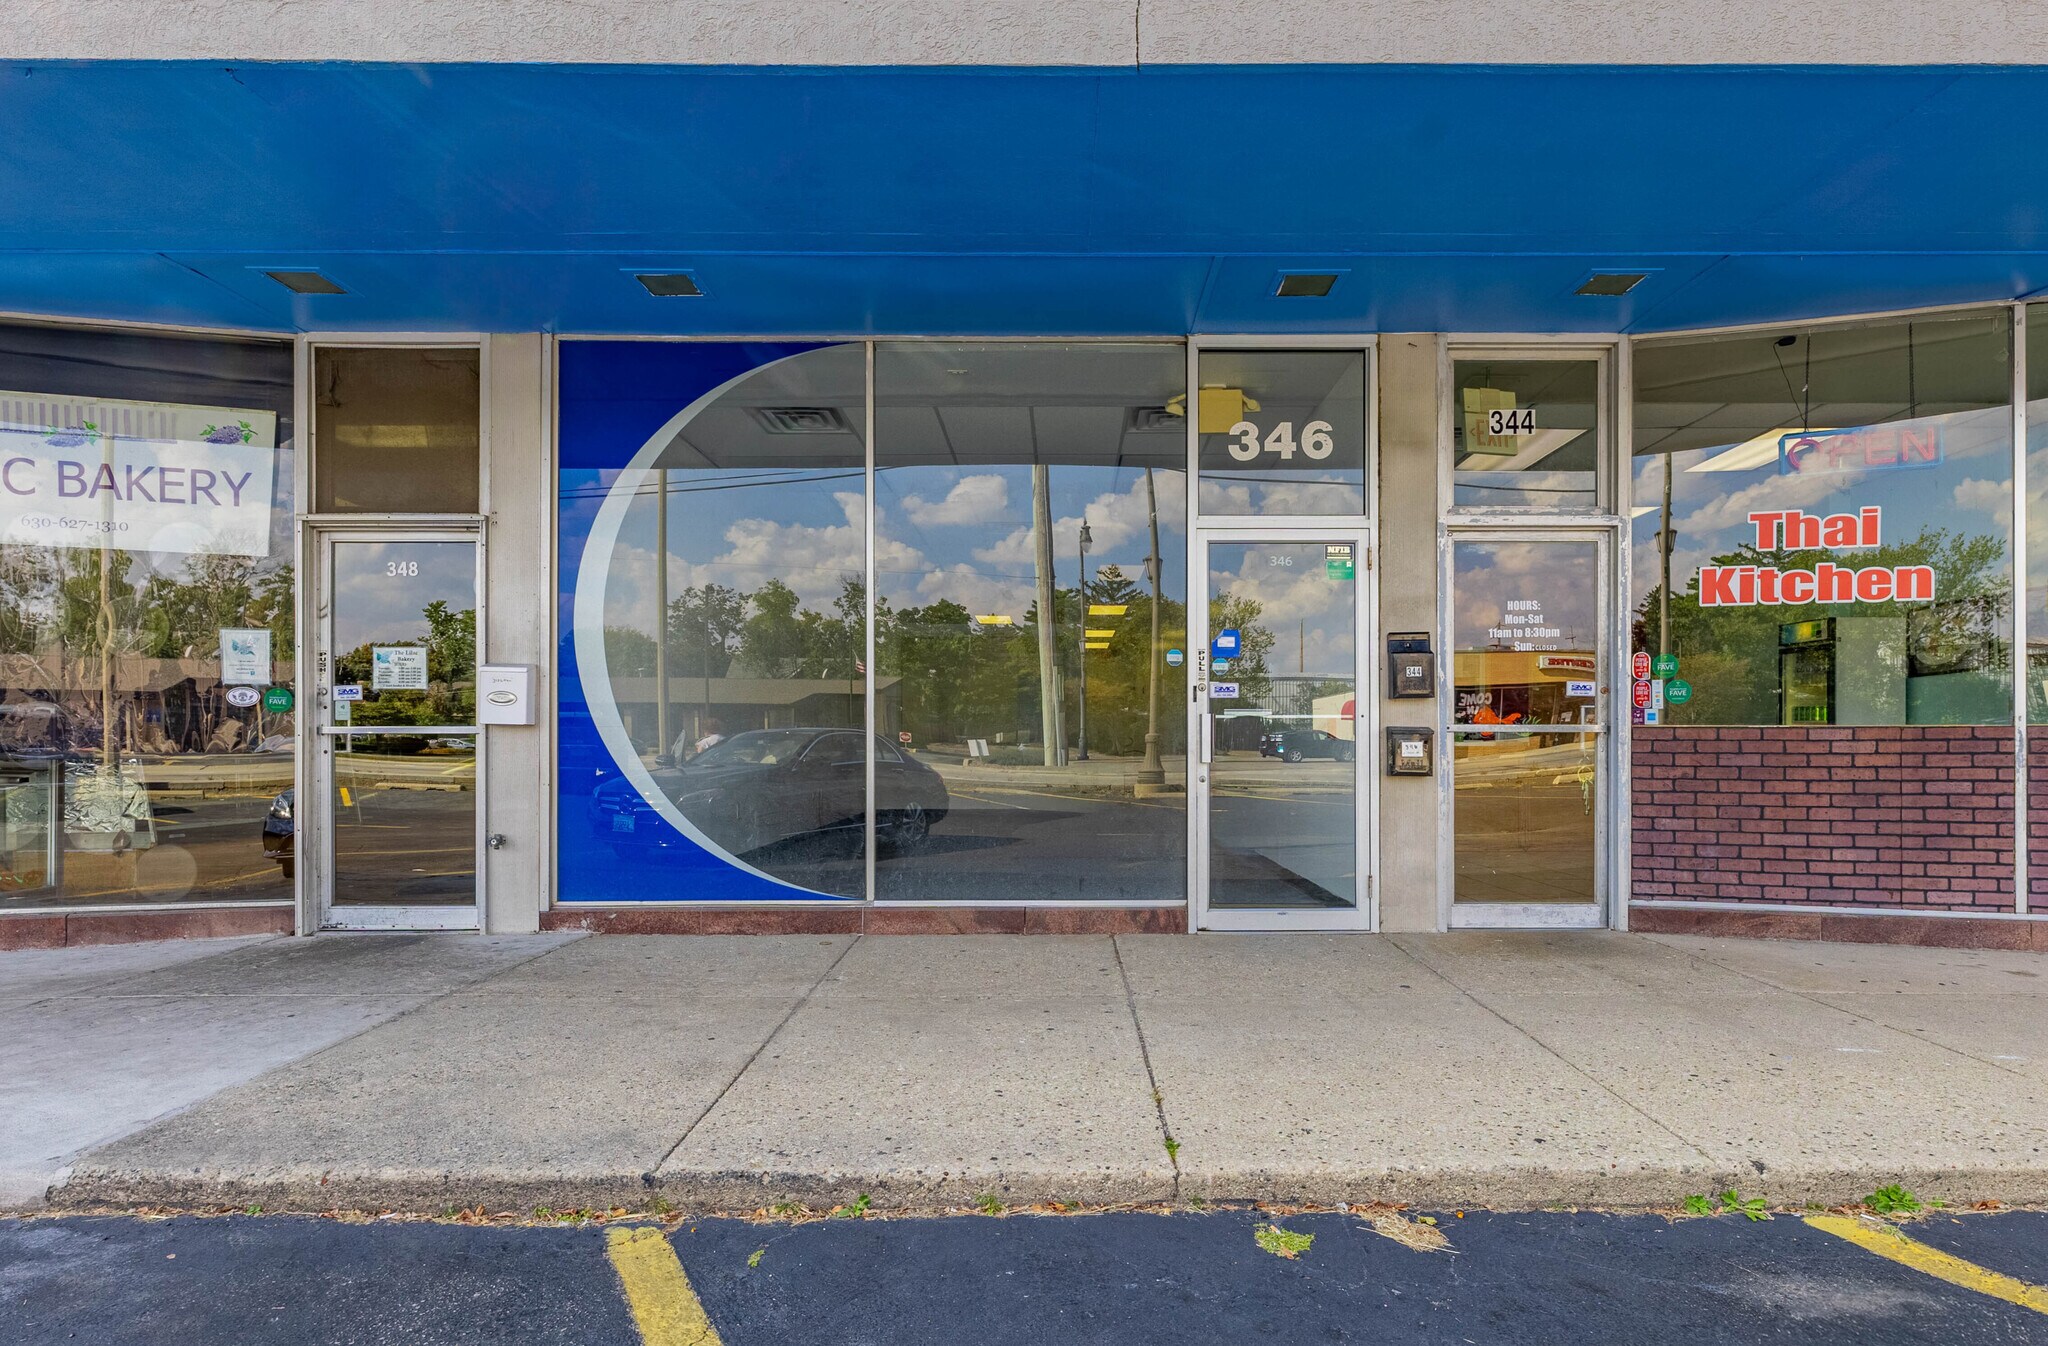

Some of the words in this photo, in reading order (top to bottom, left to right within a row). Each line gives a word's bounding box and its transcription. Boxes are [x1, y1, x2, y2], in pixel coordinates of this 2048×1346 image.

[1491, 410, 1534, 434] 344
[1228, 420, 1333, 461] 346
[1787, 426, 1935, 470] OPEN
[57, 460, 252, 507] BAKERY
[21, 516, 129, 533] 630-627-1310
[1748, 506, 1881, 551] Thai
[386, 561, 419, 577] 348
[1270, 556, 1293, 566] 346
[1699, 562, 1935, 607] Kitchen
[1507, 600, 1541, 611] HOURS:
[1505, 614, 1544, 624] Mon-Sat
[1488, 628, 1512, 638] 11am
[1513, 628, 1523, 638] to
[1525, 627, 1560, 638] 8:30pm
[1514, 641, 1535, 651] Sun:
[1198, 650, 1206, 672] PULL
[1406, 667, 1421, 677] 344
